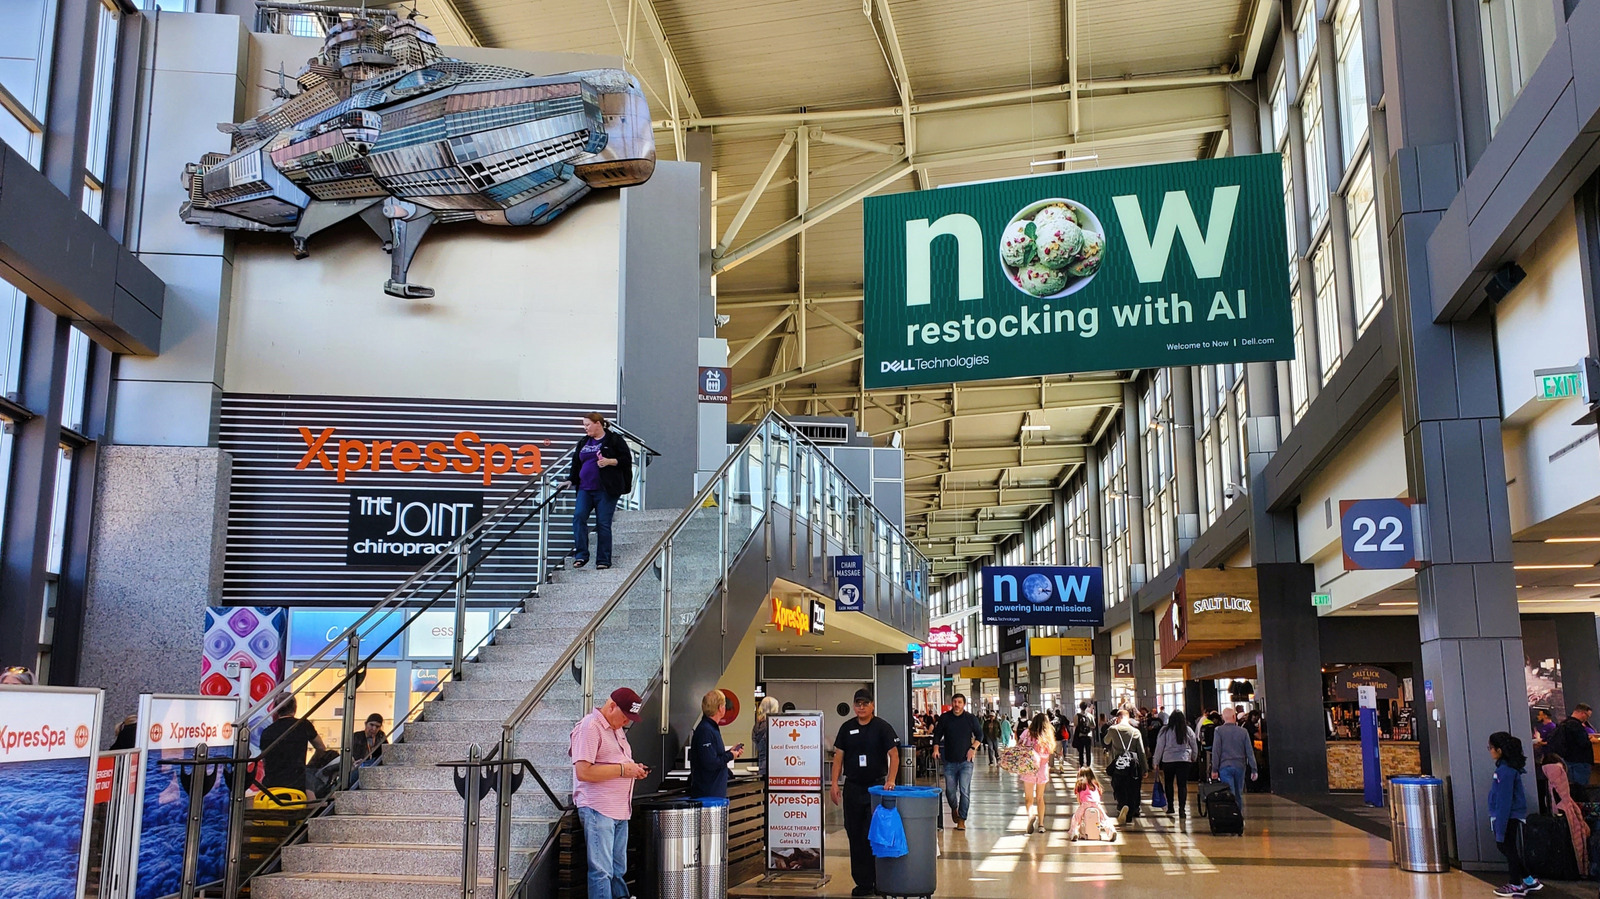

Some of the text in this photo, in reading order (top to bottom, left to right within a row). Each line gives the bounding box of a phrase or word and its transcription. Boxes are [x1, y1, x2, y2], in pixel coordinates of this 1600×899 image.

[906, 289, 1247, 346] restocking with AI
[1166, 342, 1201, 351] Welcome
[1241, 338, 1275, 346] Dell.com
[1543, 374, 1577, 398] EXIT
[357, 496, 392, 515] THE
[387, 502, 474, 537] JOINT
[1352, 516, 1405, 552] 22
[836, 569, 861, 577] MASSAGE
[1193, 597, 1253, 614] SALT LICK
[1314, 594, 1330, 605] EXIT
[994, 603, 1092, 613] powering lunar missions
[773, 597, 810, 636] XpresSpa
[1118, 663, 1131, 674] 21
[772, 718, 817, 728] XpresSpa
[170, 722, 217, 742] XpresSpa
[769, 793, 820, 806] XpresSpa
[783, 811, 807, 819] OPEN
